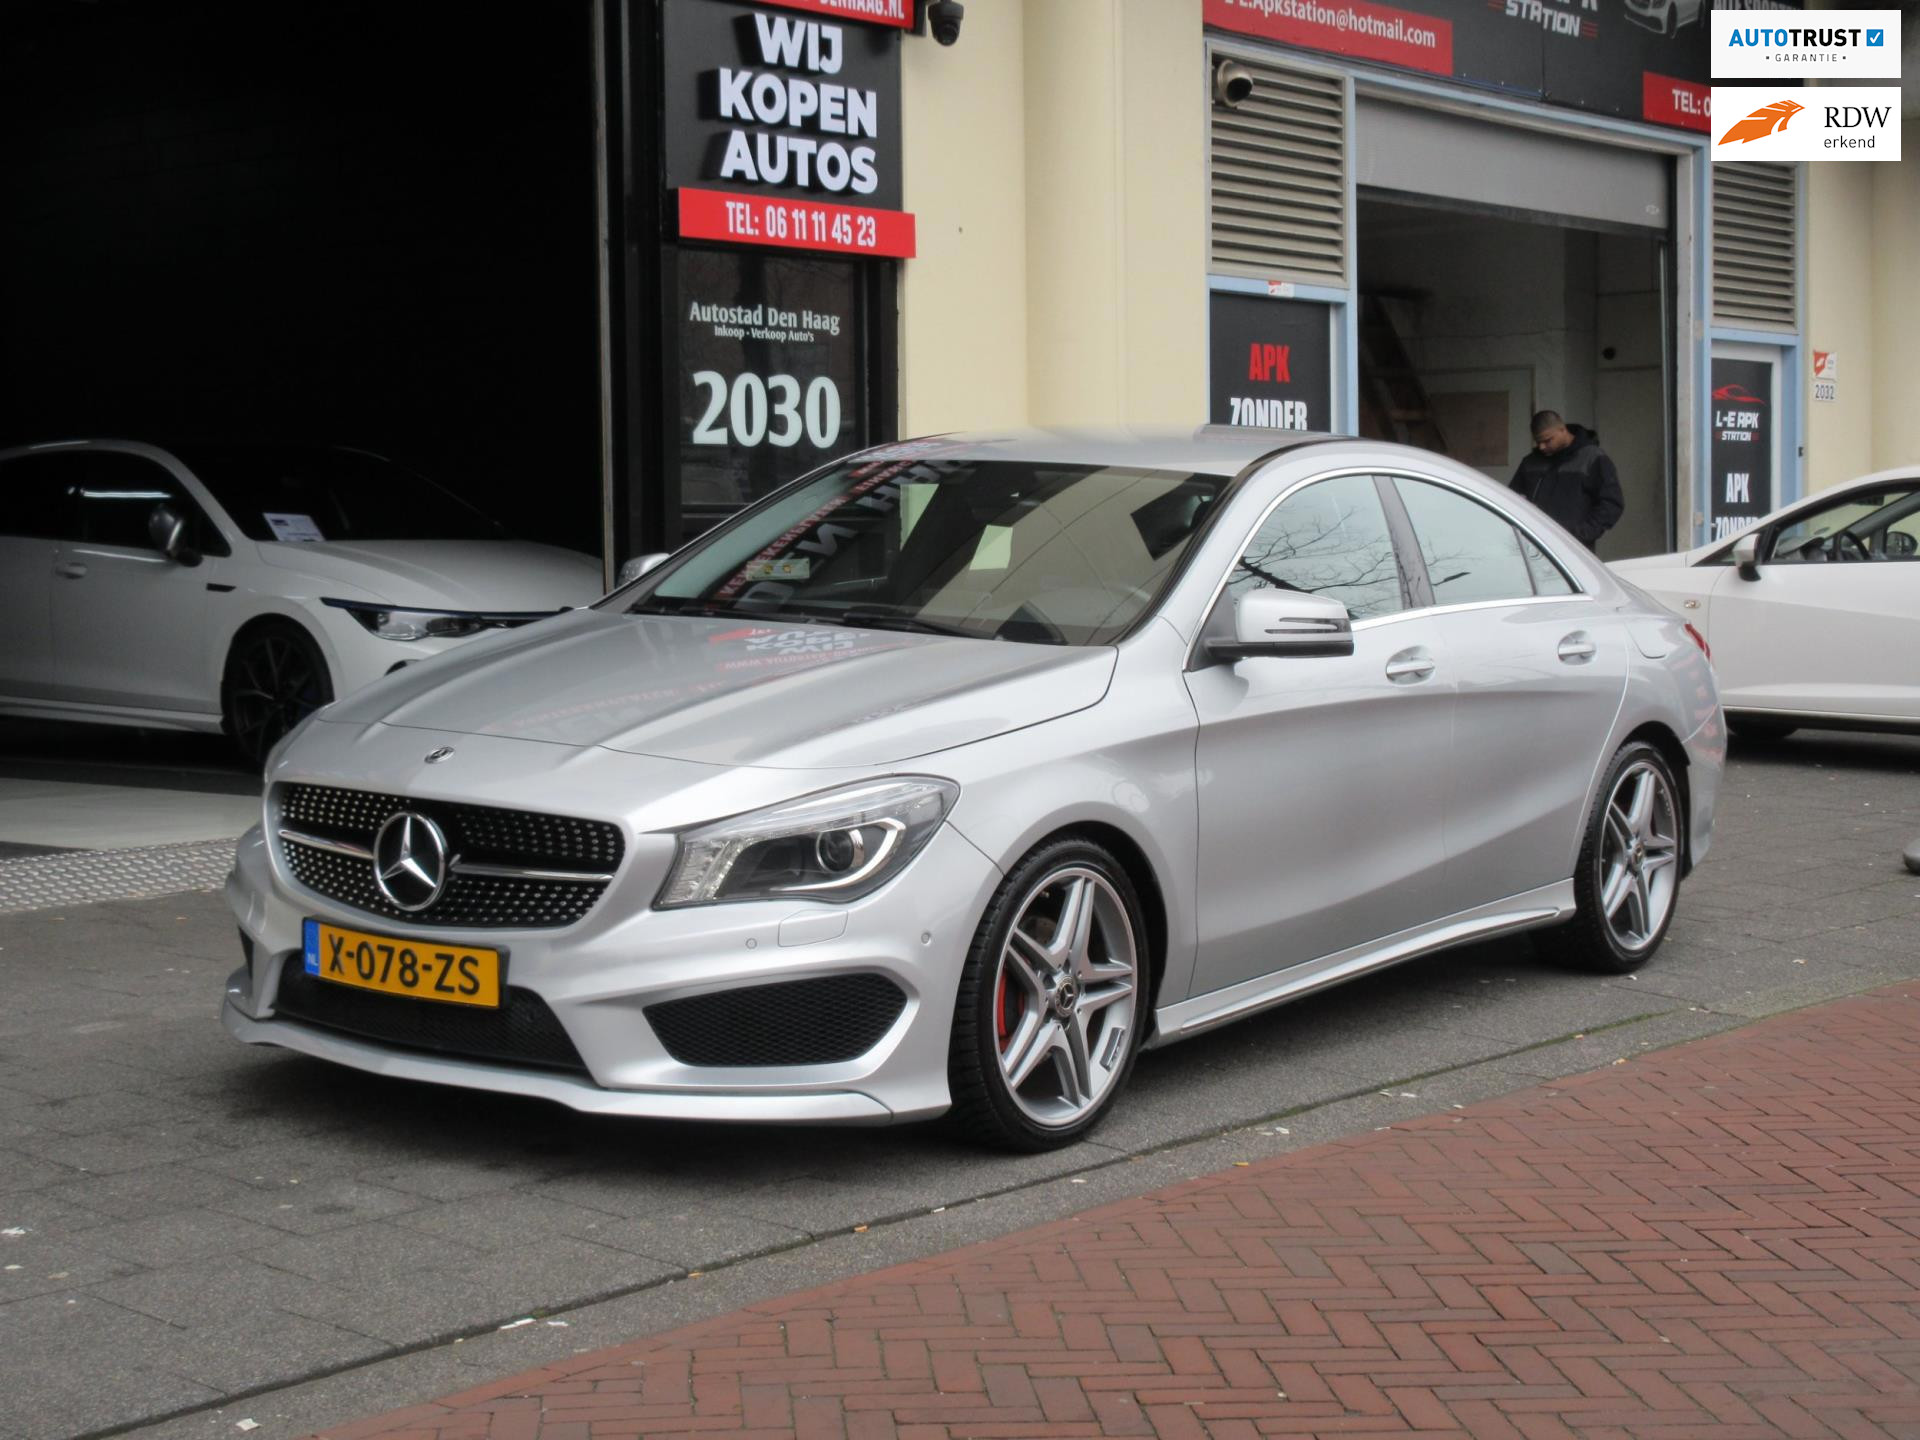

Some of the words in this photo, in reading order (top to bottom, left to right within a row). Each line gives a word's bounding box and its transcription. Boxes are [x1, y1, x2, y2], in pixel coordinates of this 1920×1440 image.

[1505, 0, 1581, 37] STATION
[754, 13, 843, 74] WIJ
[719, 67, 877, 138] KOPEN
[1672, 88, 1701, 115] TEL:
[720, 129, 878, 194] AUTOS
[725, 201, 759, 236] TEL:
[765, 205, 787, 239] 06
[791, 208, 807, 240] 11
[811, 210, 826, 242] 11
[831, 213, 852, 245] 45
[857, 215, 876, 247] 23
[689, 301, 763, 325] Autostad
[767, 307, 797, 328] Den
[802, 310, 840, 336] Haag
[714, 320, 745, 340] Inkoop
[751, 328, 786, 343] Verkoop
[788, 330, 815, 343] Auto's
[1249, 343, 1290, 383] APK
[692, 370, 841, 449] 2030
[1815, 384, 1834, 399] 2032
[1726, 472, 1749, 503] APK
[328, 933, 480, 996] X-078-ZS
